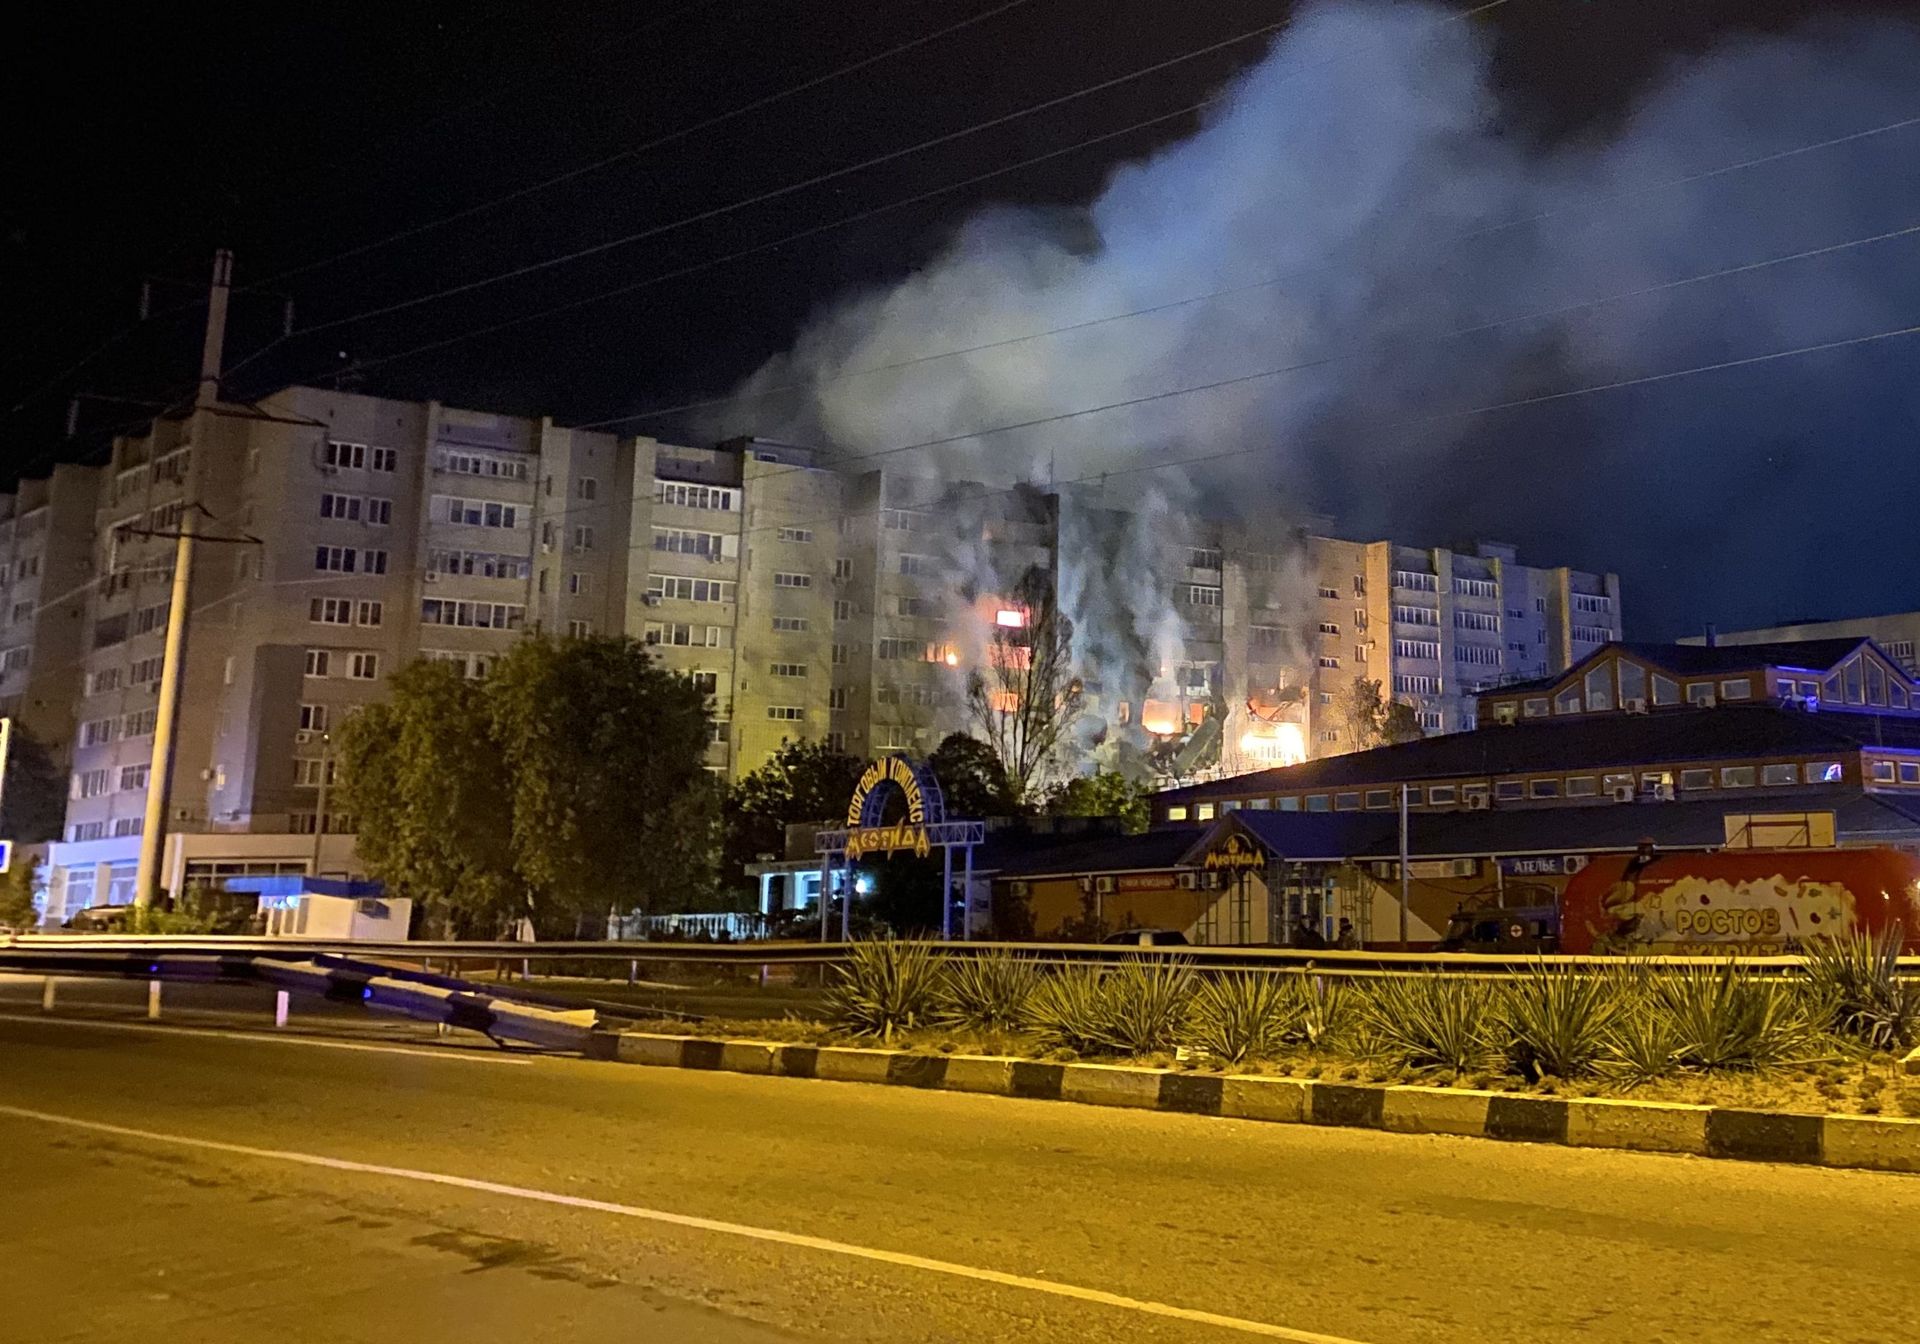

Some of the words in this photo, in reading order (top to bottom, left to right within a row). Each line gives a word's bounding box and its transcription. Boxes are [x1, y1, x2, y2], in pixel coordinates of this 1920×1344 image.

[847, 755, 887, 827] ТОРГОВЫЙ
[889, 756, 923, 823] КОМПЛЕКС
[1514, 859, 1556, 873] АТЕЛЬЕ
[1676, 908, 1781, 935] РОСТОВ
